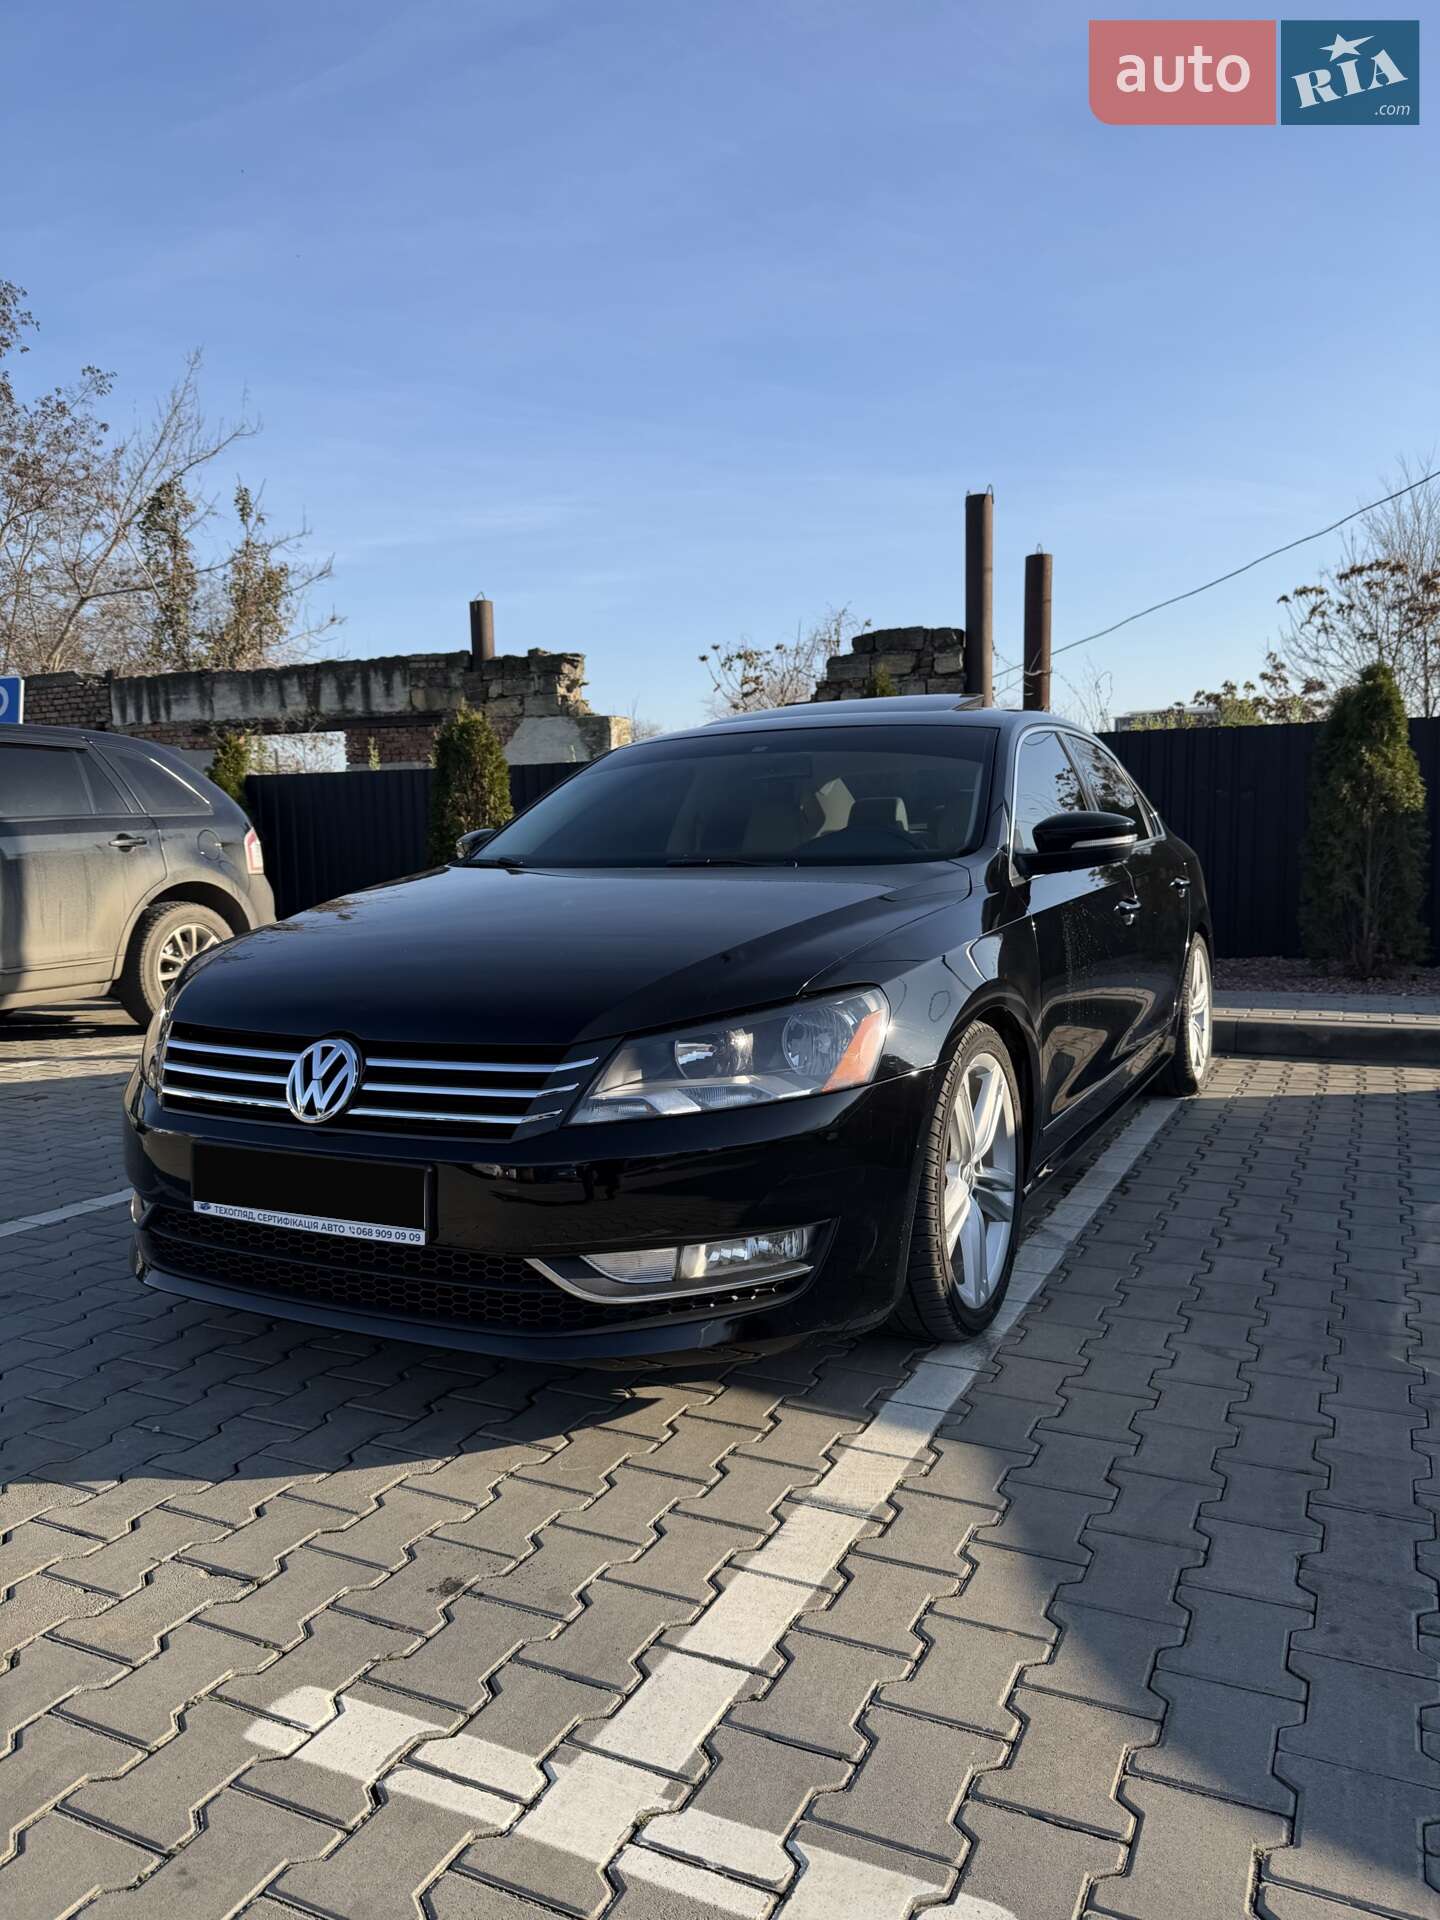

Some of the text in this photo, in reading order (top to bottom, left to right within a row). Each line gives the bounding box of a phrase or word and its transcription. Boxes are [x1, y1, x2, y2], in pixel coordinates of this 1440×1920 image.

[257, 1212, 319, 1231] СЕРТИФІКАЦІЯ
[320, 1222, 346, 1234] АВТО
[356, 1226, 374, 1237] 068
[375, 1229, 393, 1239] 909
[394, 1231, 407, 1241] 09
[408, 1233, 421, 1242] 09
